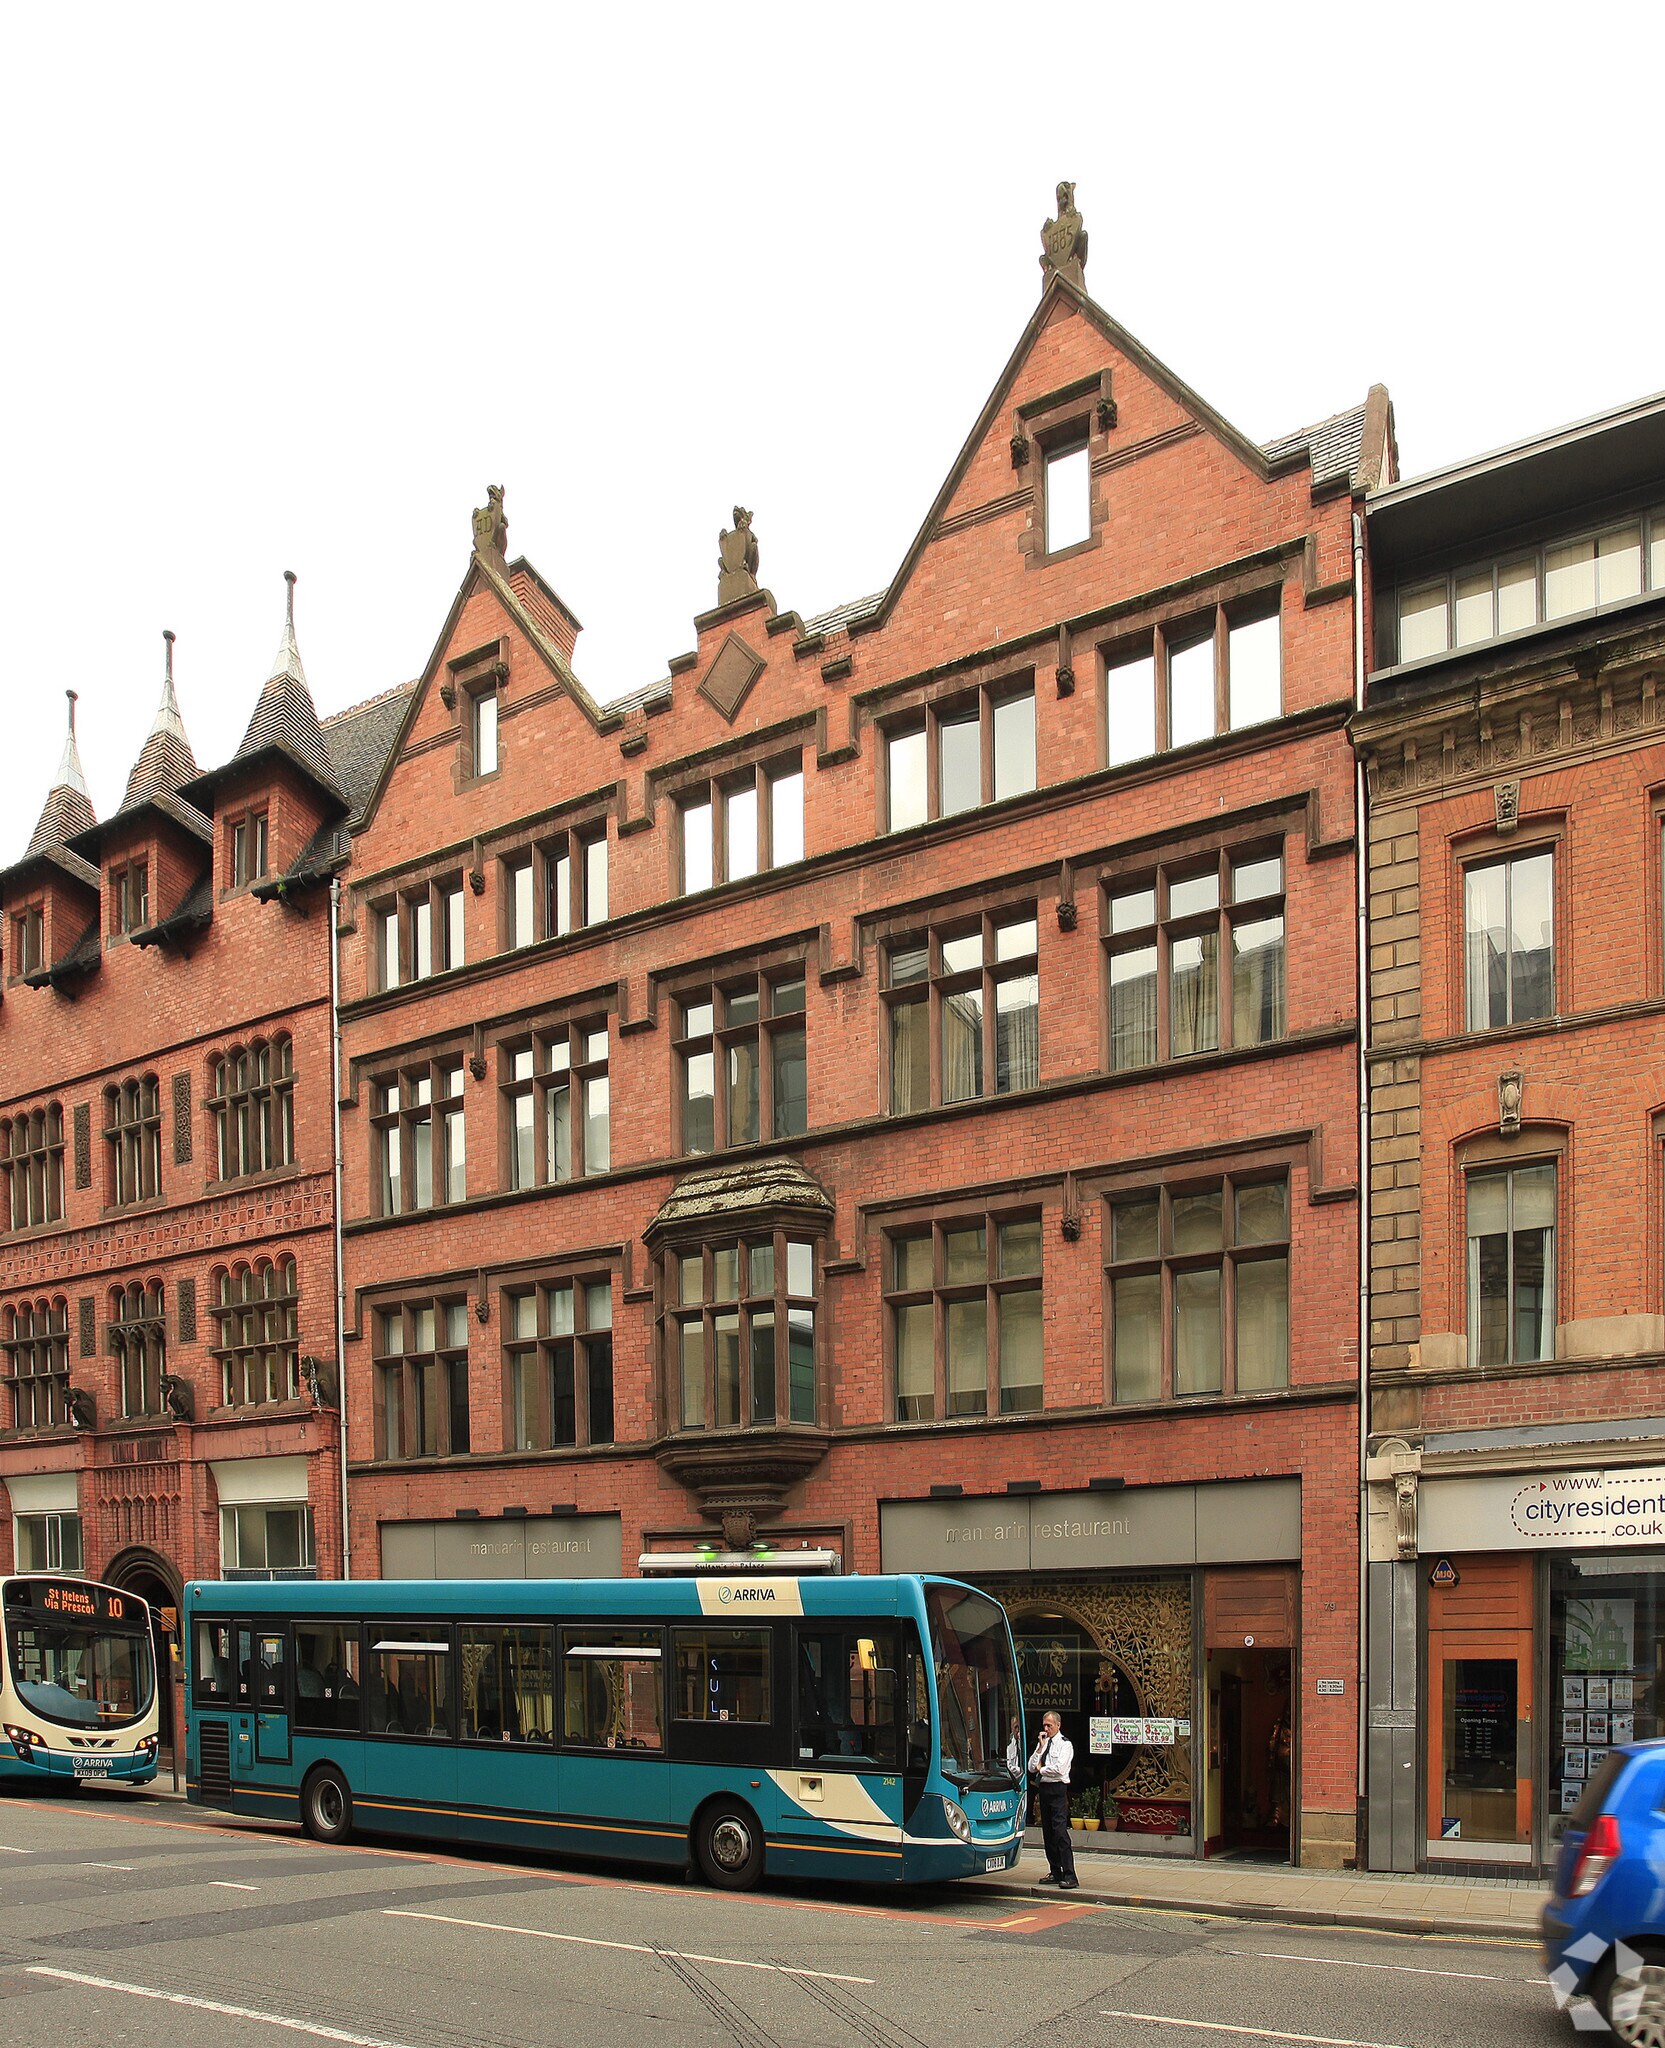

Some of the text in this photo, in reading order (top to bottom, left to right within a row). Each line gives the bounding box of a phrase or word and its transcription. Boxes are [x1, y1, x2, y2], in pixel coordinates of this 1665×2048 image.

[1048, 225, 1073, 253] 1885
[1552, 1477, 1602, 1491] www.
[1034, 1516, 1131, 1538] restaurant
[1611, 1520, 1663, 1537] .co.uk
[527, 1538, 591, 1554] restaurant
[1436, 1570, 1452, 1579] MJQ
[48, 1588, 90, 1604] St Helens
[733, 1588, 776, 1601] ARRIVA
[44, 1597, 95, 1615] Via Prescot
[107, 1597, 123, 1618] 10
[1324, 1602, 1336, 1611] 79
[1113, 1723, 1120, 1733] 4
[1144, 1724, 1151, 1734] 3
[83, 1759, 114, 1767] ARRIVA
[988, 1799, 1007, 1813] ARRIVA
